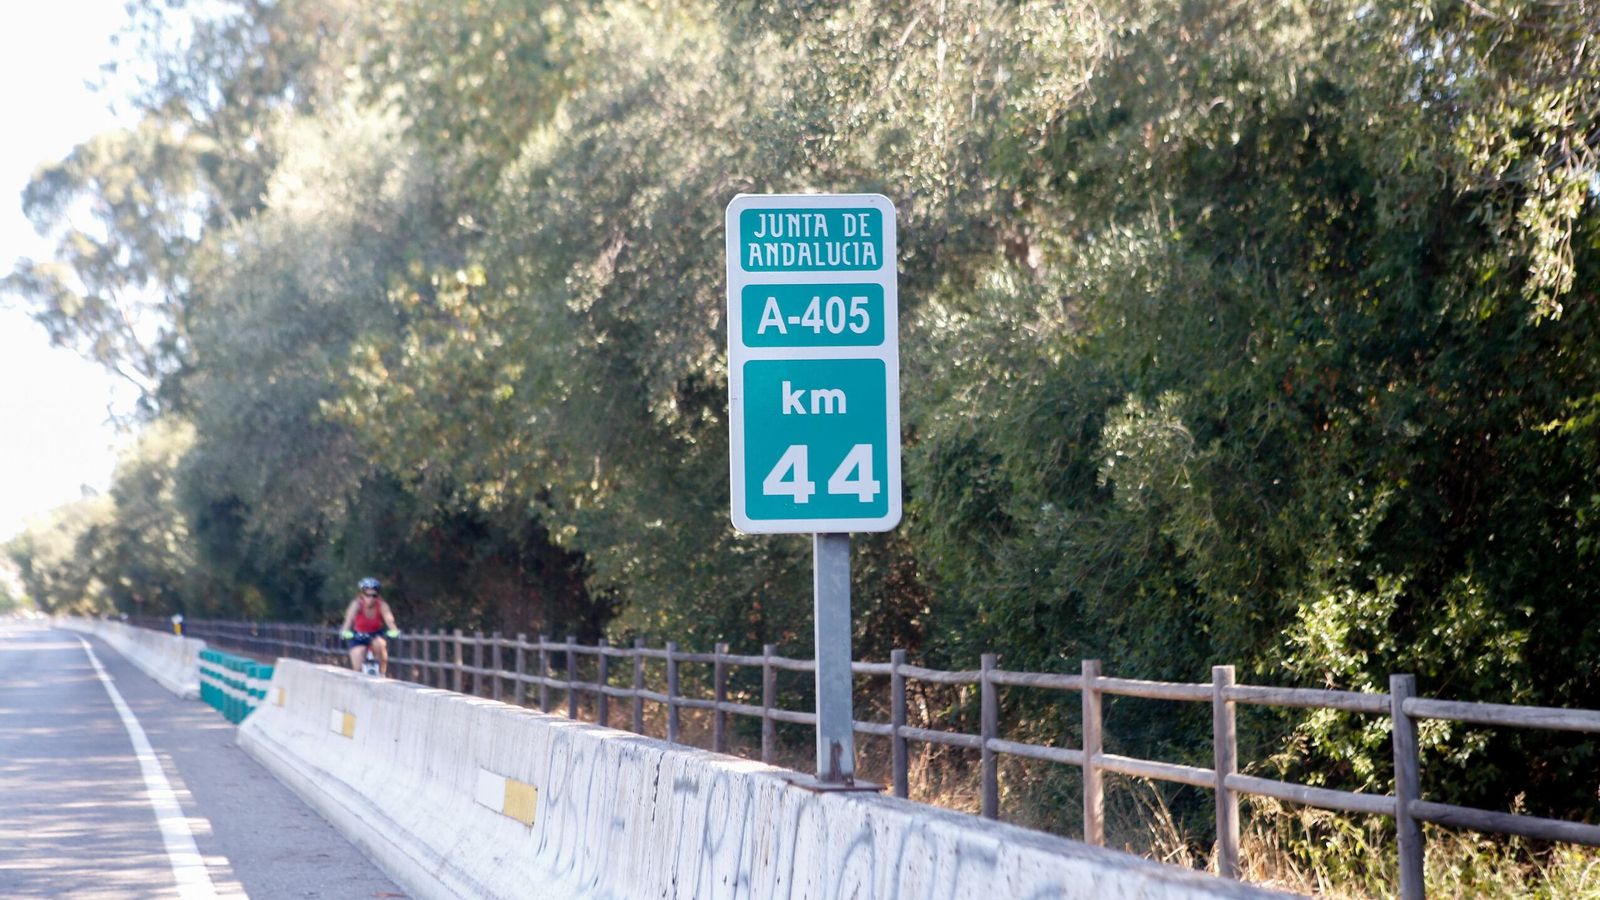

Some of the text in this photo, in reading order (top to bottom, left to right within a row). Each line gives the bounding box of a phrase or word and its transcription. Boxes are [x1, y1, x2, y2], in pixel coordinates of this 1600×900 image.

[754, 213, 871, 238] JUNTA DE
[748, 241, 877, 266] ANDALUCIA
[757, 296, 870, 335] A-405
[782, 380, 847, 415] km
[762, 443, 881, 504] 44
